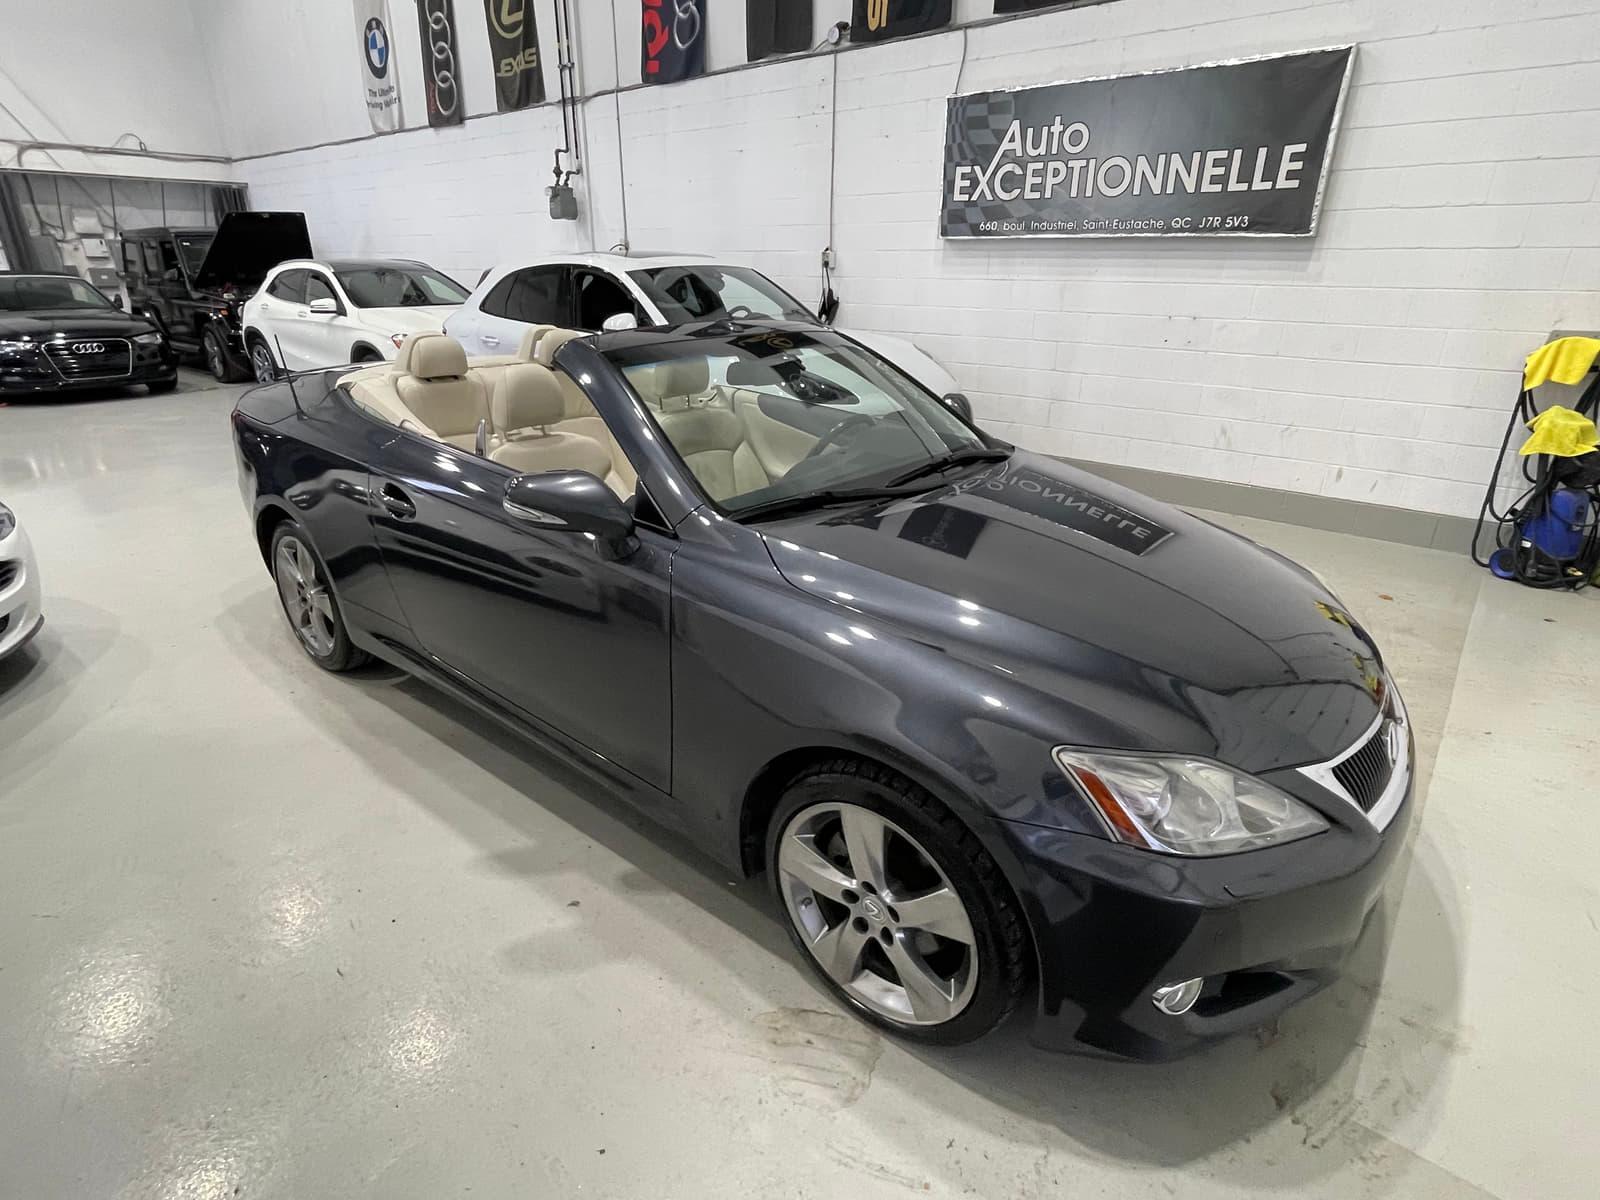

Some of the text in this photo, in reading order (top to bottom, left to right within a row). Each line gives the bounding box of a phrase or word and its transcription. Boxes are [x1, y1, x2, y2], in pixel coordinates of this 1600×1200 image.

[999, 115, 1091, 160] Auto
[952, 143, 1308, 202] EXCEPTIONNELLE
[979, 220, 1000, 232] 660,
[1082, 217, 1167, 231] Saint-Eustache,
[1171, 217, 1192, 229] QC
[1199, 217, 1221, 229] J7R
[1224, 215, 1250, 228] 5V3
